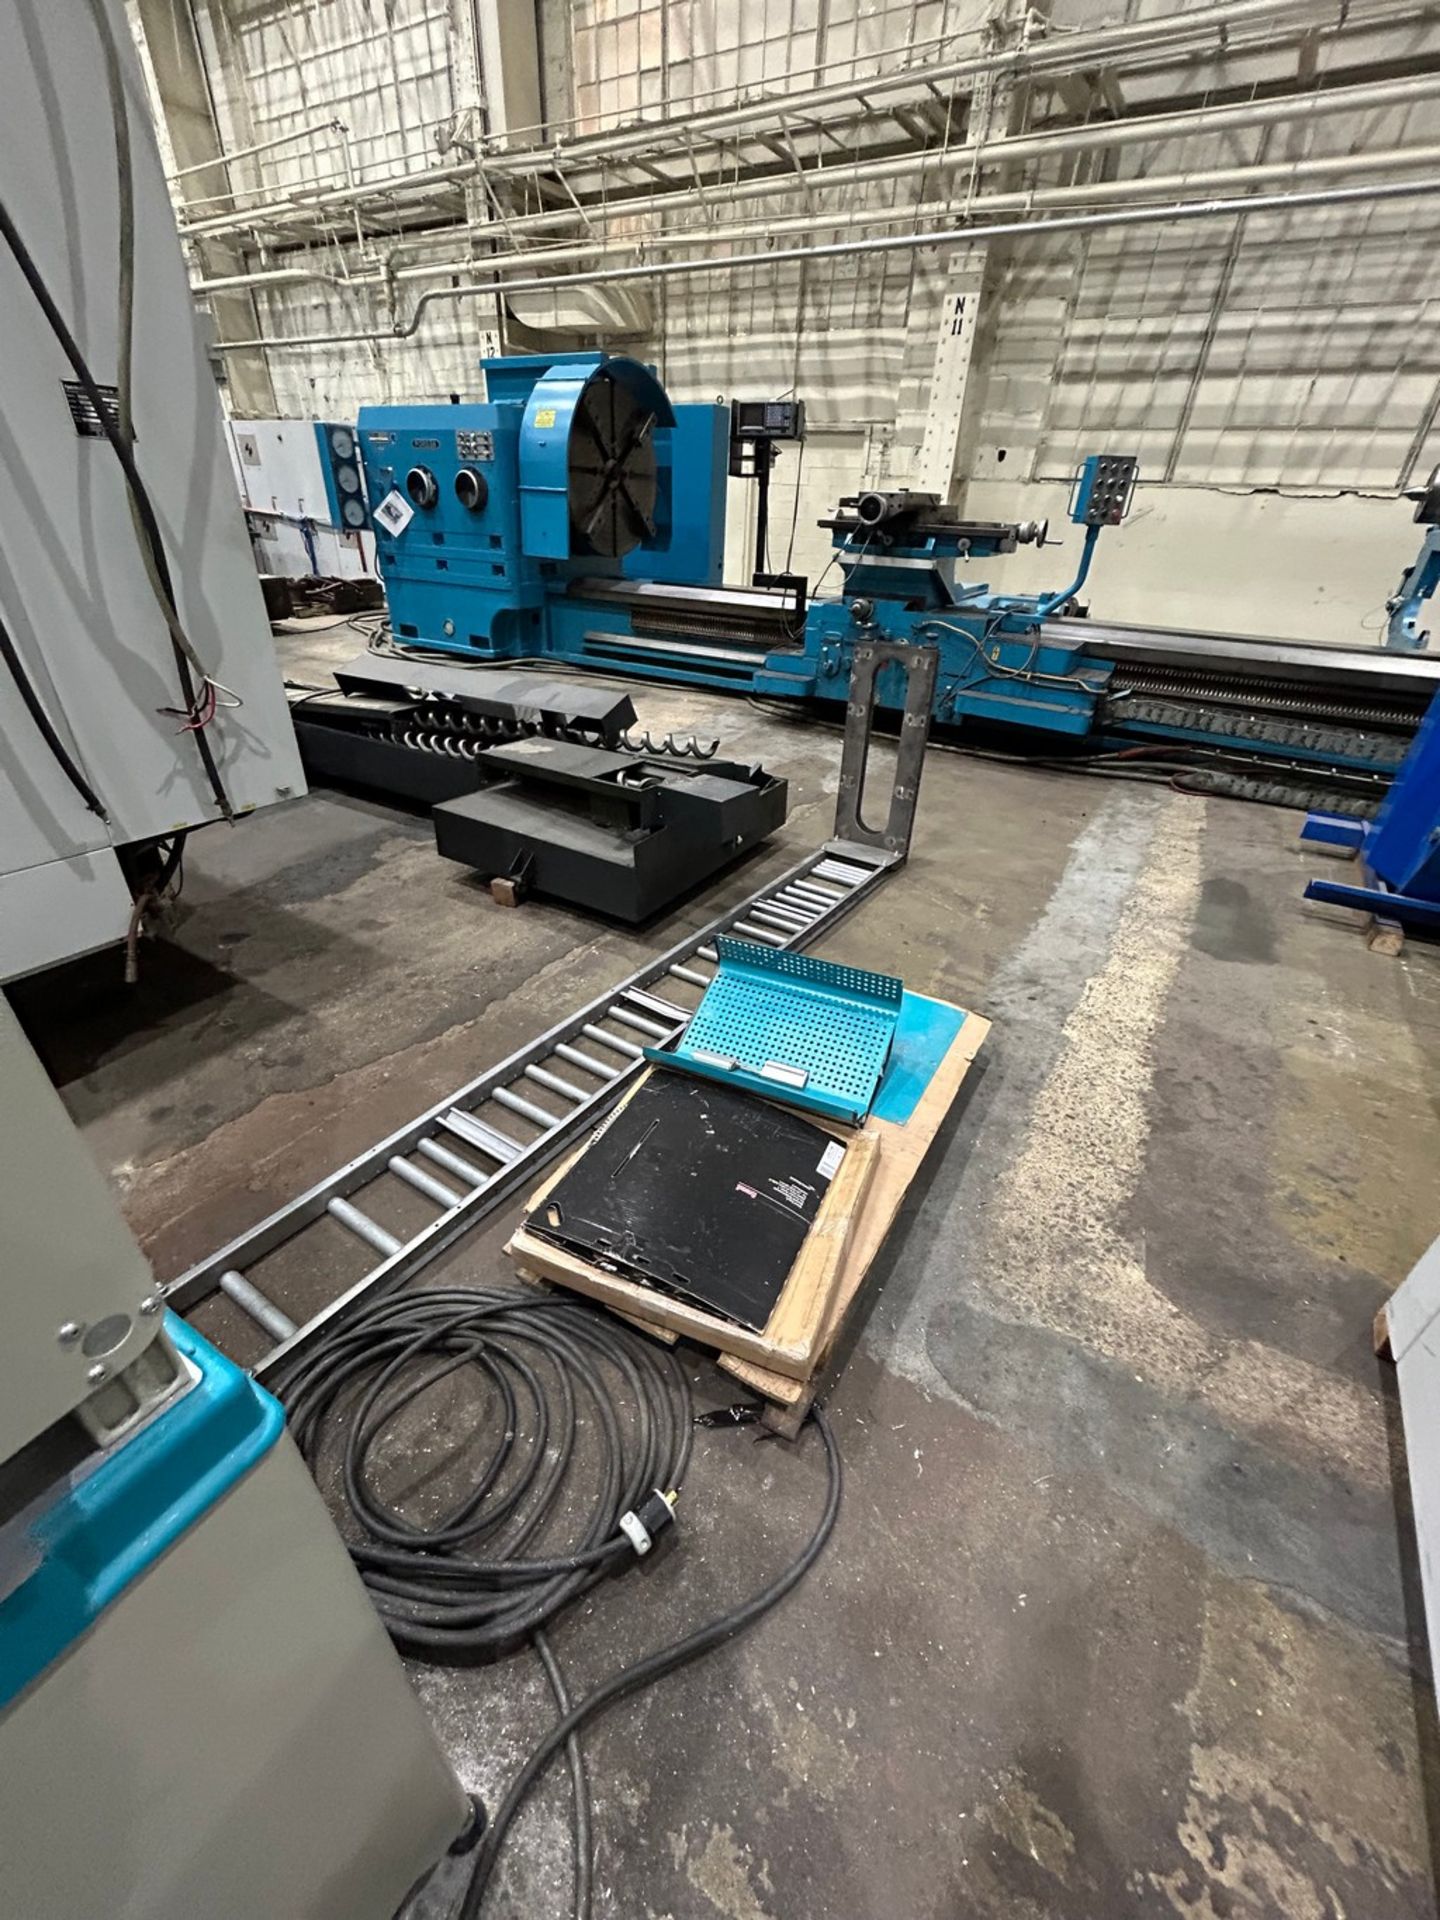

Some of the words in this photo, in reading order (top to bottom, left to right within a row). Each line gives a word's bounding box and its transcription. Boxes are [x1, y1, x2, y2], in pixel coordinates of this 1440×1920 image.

[954, 296, 966, 315] N
[951, 318, 963, 336] 11
[486, 331, 493, 345] N
